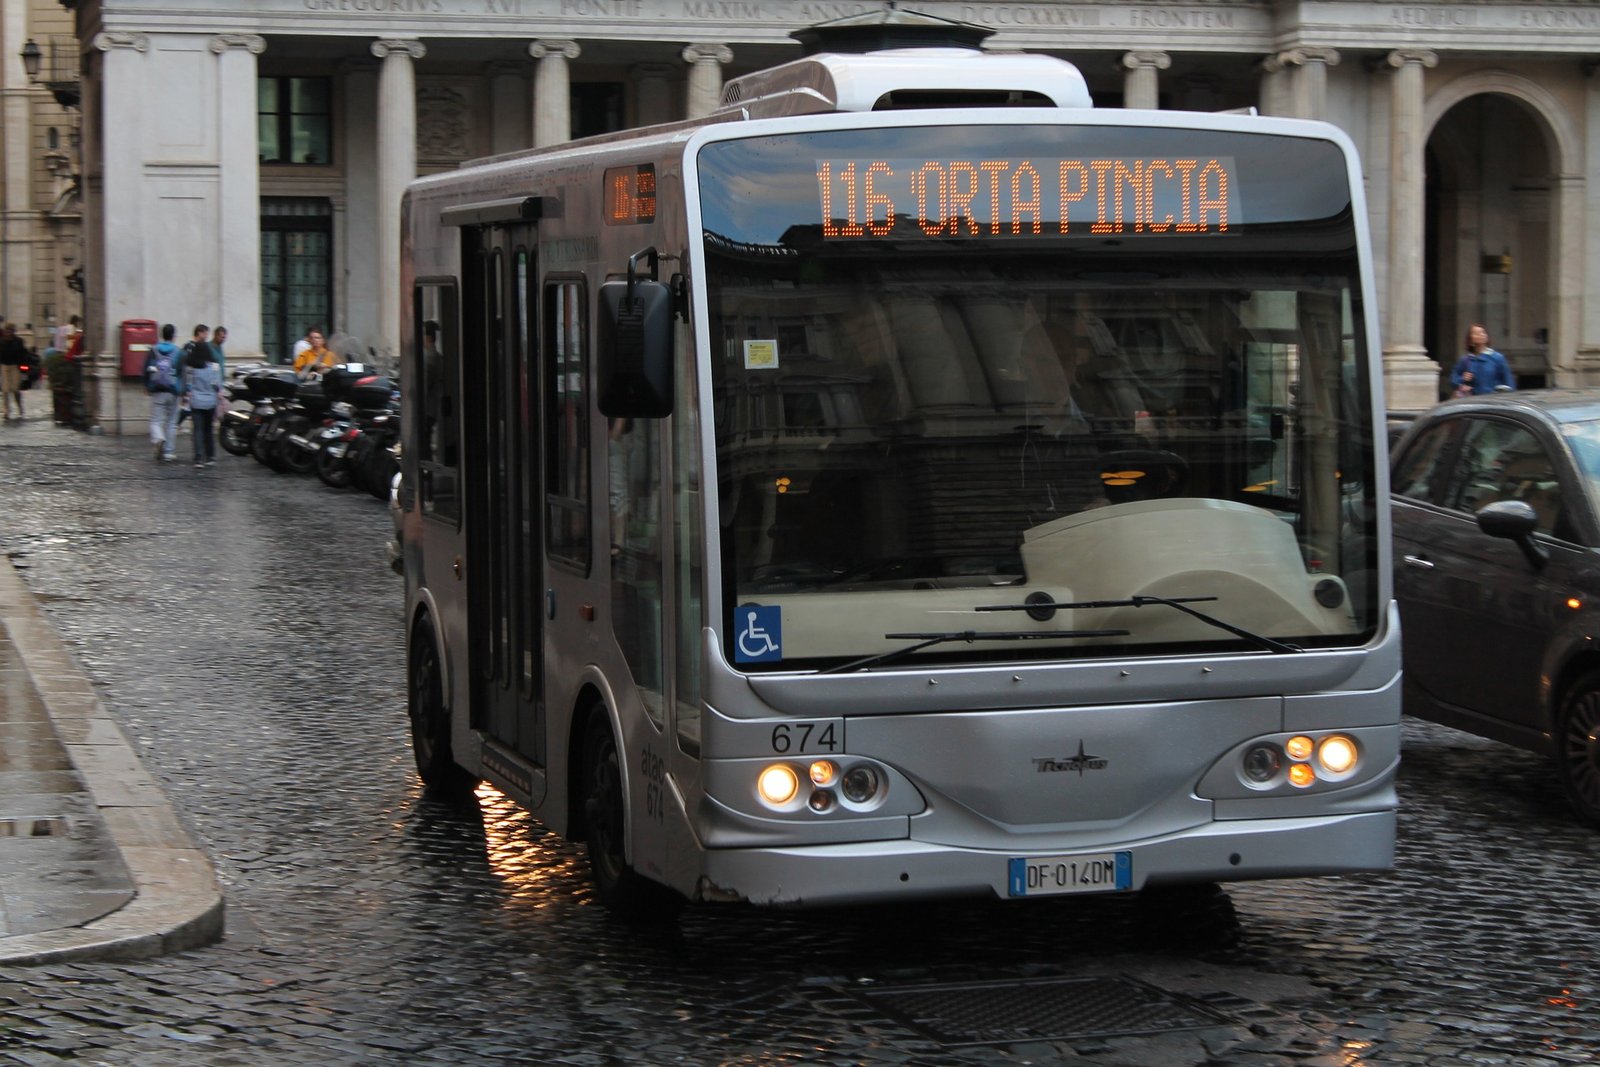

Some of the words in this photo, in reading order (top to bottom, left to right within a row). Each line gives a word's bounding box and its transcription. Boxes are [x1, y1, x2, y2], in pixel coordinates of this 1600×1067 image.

[485, 0, 522, 15] XVI
[1129, 9, 1234, 28] FRONTEM
[816, 161, 896, 236] 116
[911, 161, 1041, 236] ORTA
[1059, 159, 1229, 235] PINCIA
[771, 722, 838, 753] 674
